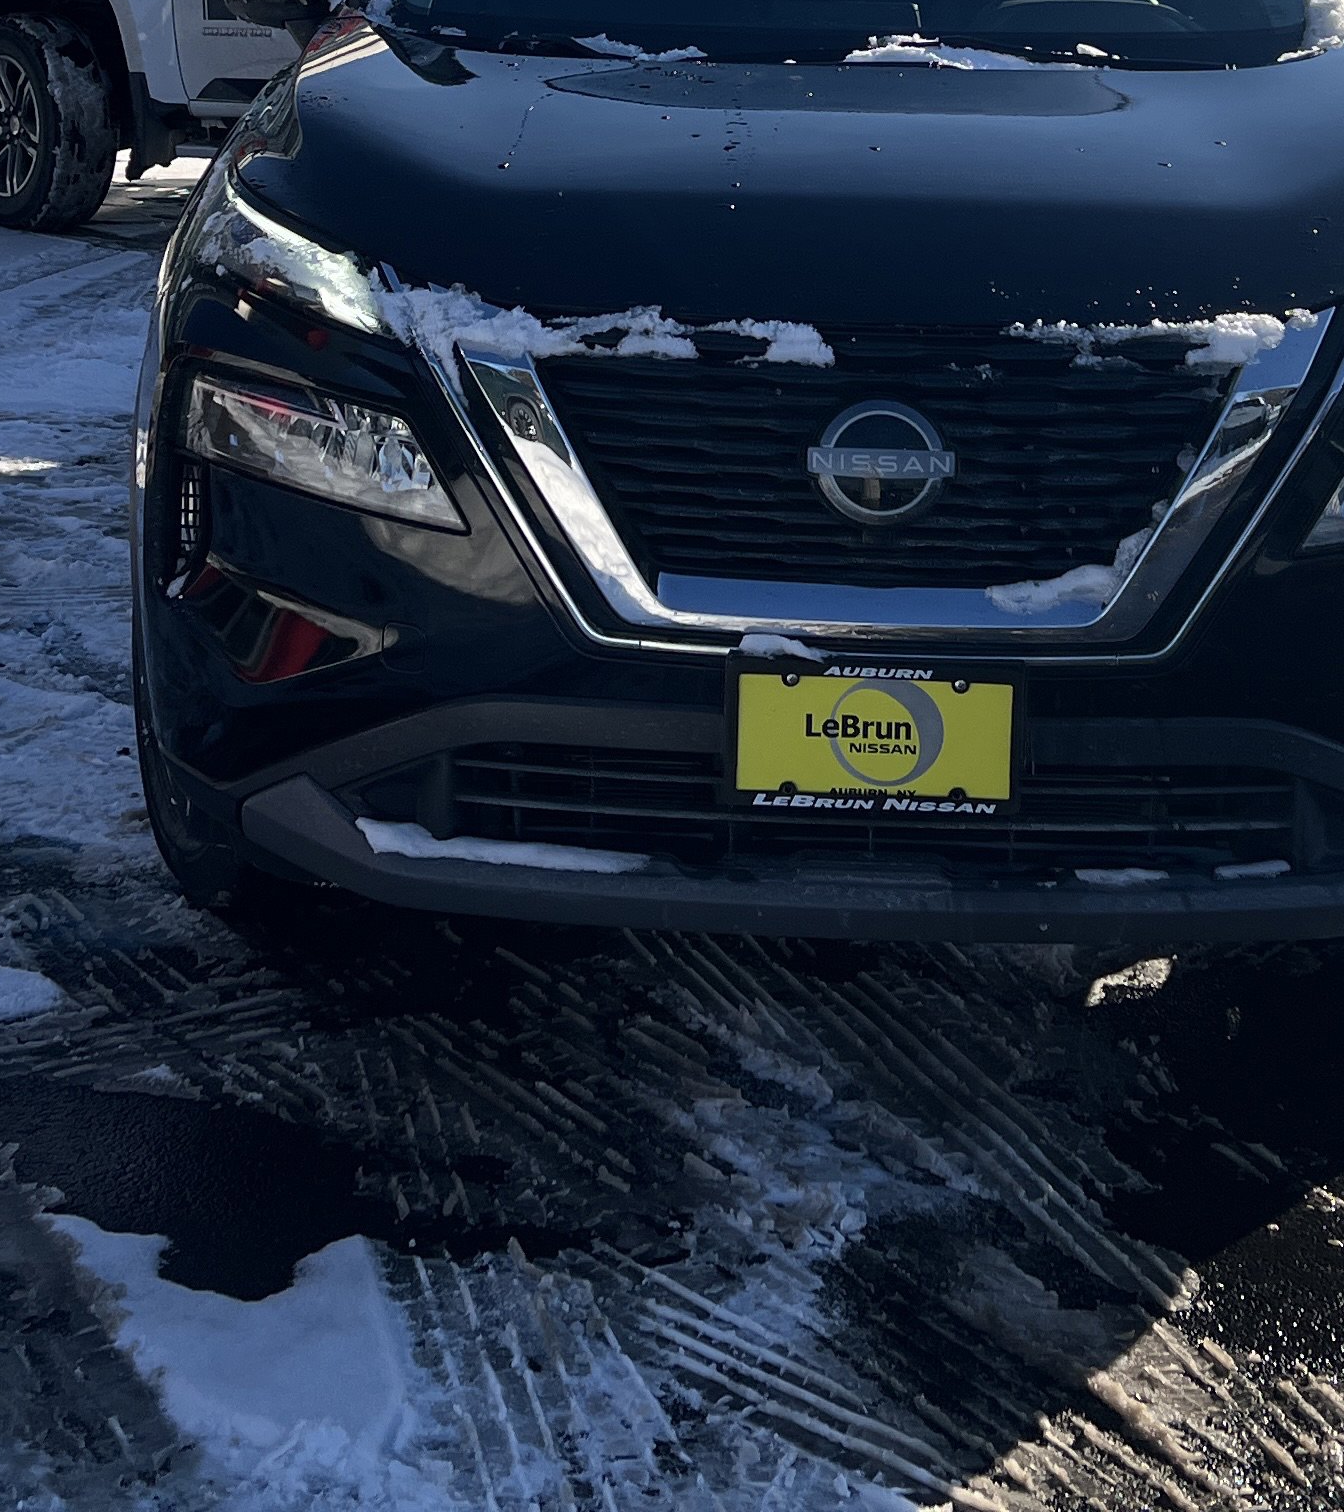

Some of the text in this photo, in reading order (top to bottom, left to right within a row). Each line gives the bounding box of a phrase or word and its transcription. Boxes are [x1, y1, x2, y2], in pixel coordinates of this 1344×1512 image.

[811, 451, 951, 474] NISSAN
[823, 665, 934, 680] AUBURN
[805, 712, 913, 741] LeBrun
[849, 742, 917, 756] NISSAN
